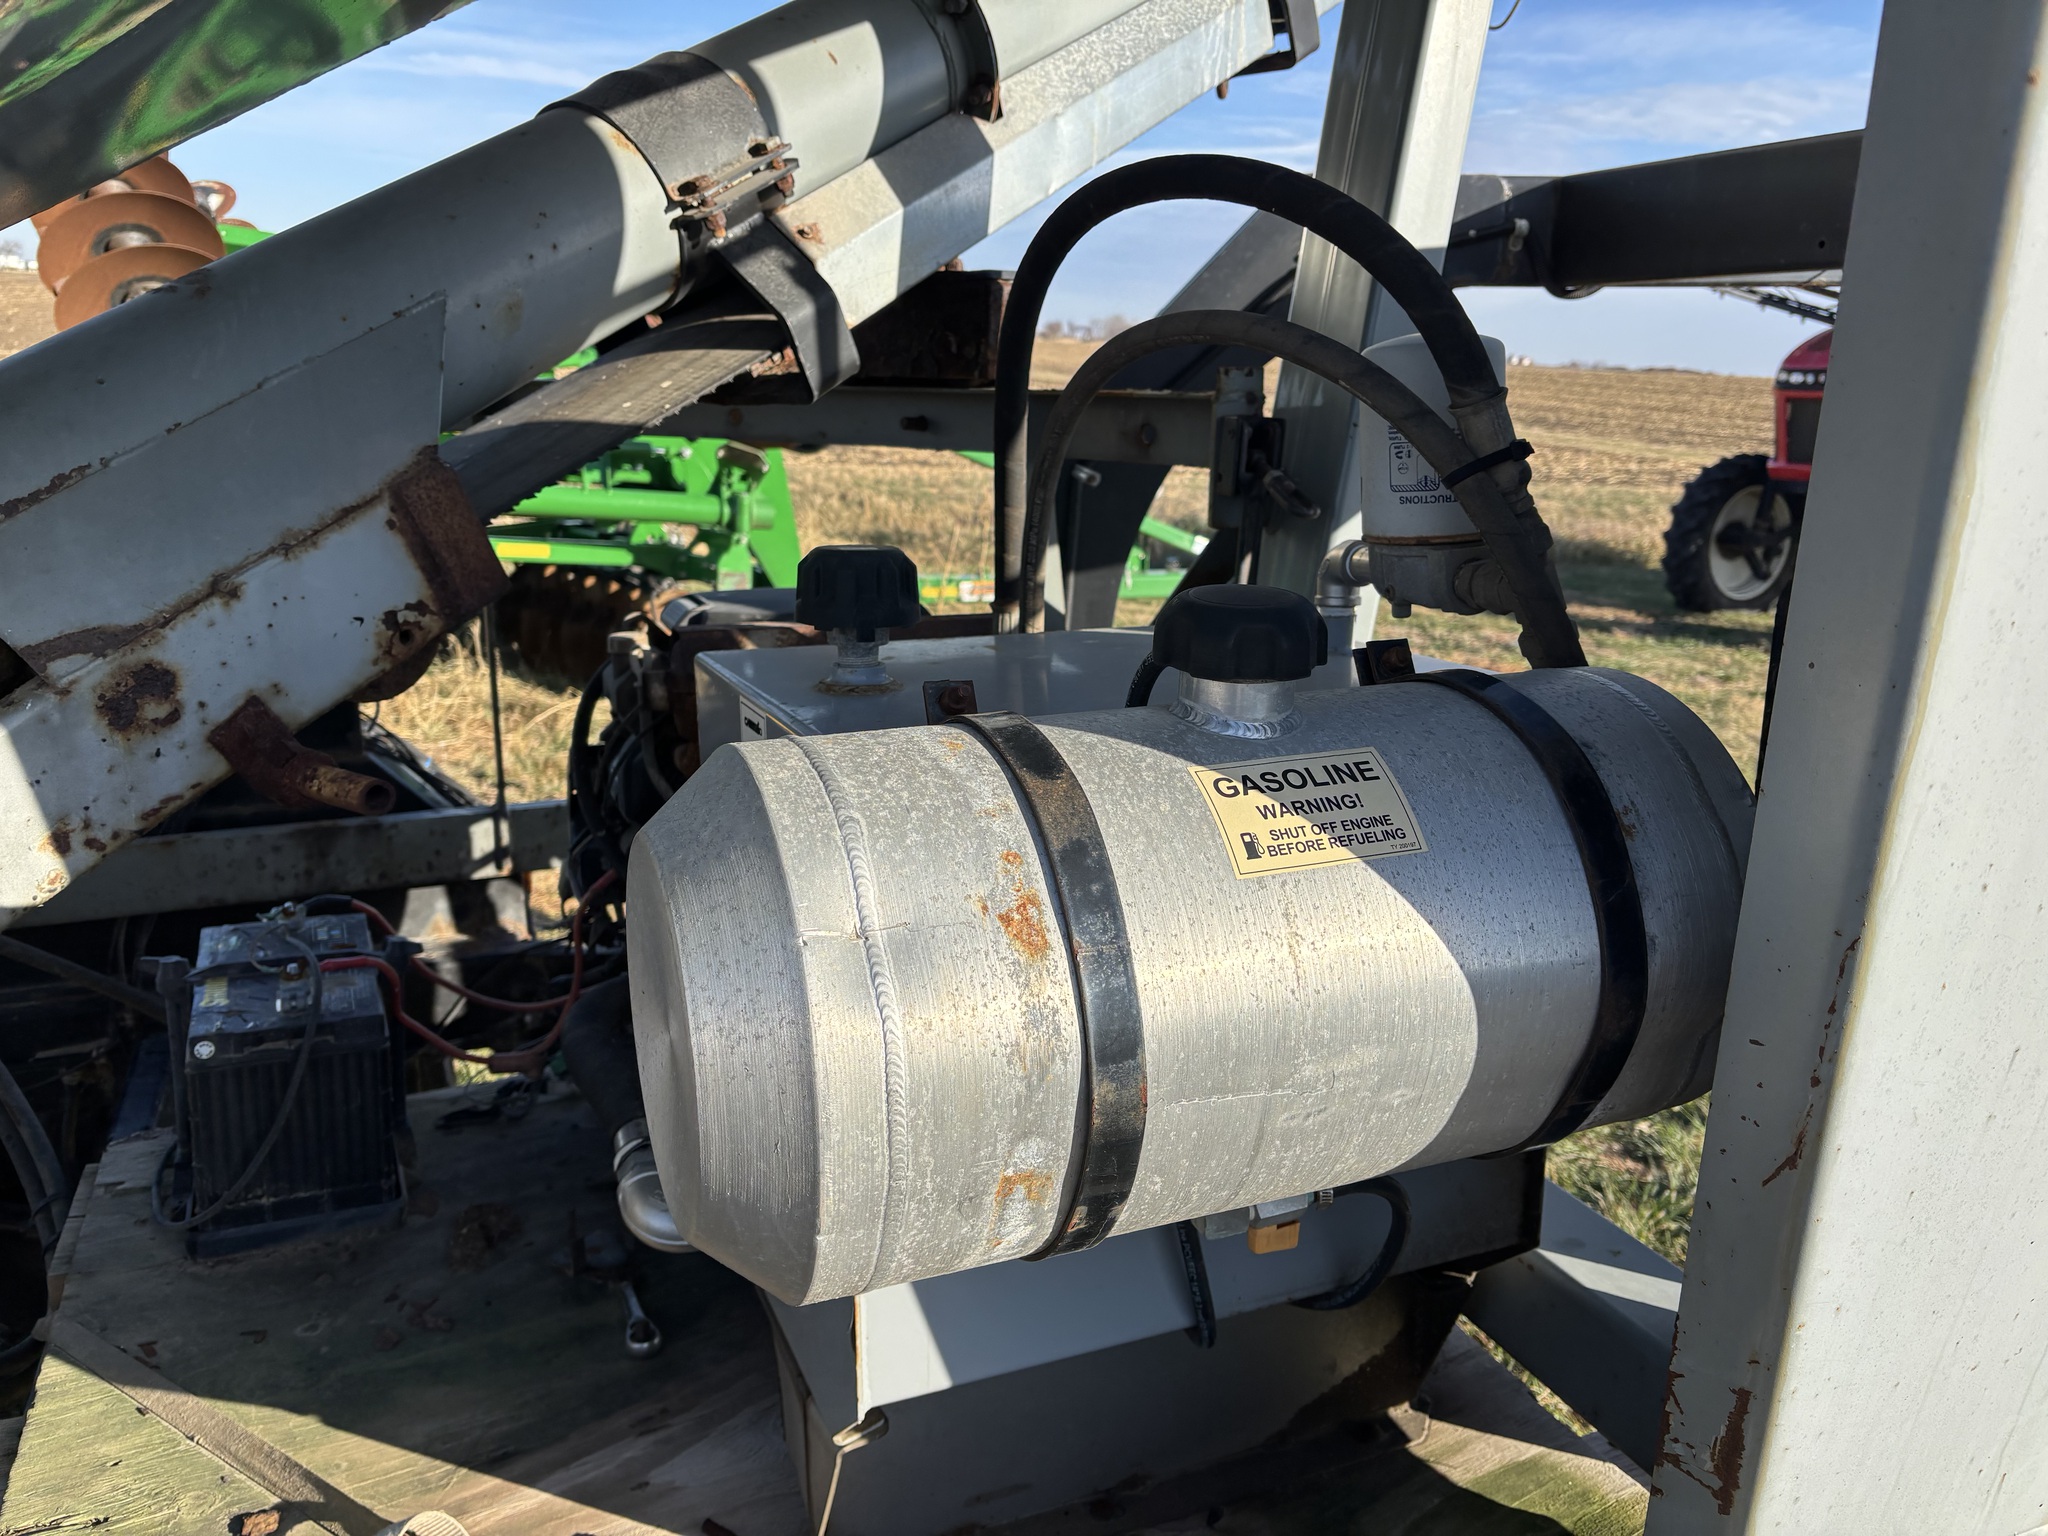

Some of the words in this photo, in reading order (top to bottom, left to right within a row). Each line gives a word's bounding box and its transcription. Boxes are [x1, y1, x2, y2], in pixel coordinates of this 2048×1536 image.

[1213, 760, 1380, 798] GASOLINE
[1255, 793, 1364, 820] WARNING!
[1269, 826, 1307, 841] SHUT
[1310, 821, 1338, 835] OFF
[1342, 814, 1394, 832] ENGINE
[1267, 838, 1327, 857] BEFORE
[1329, 827, 1406, 848] REFUELING
